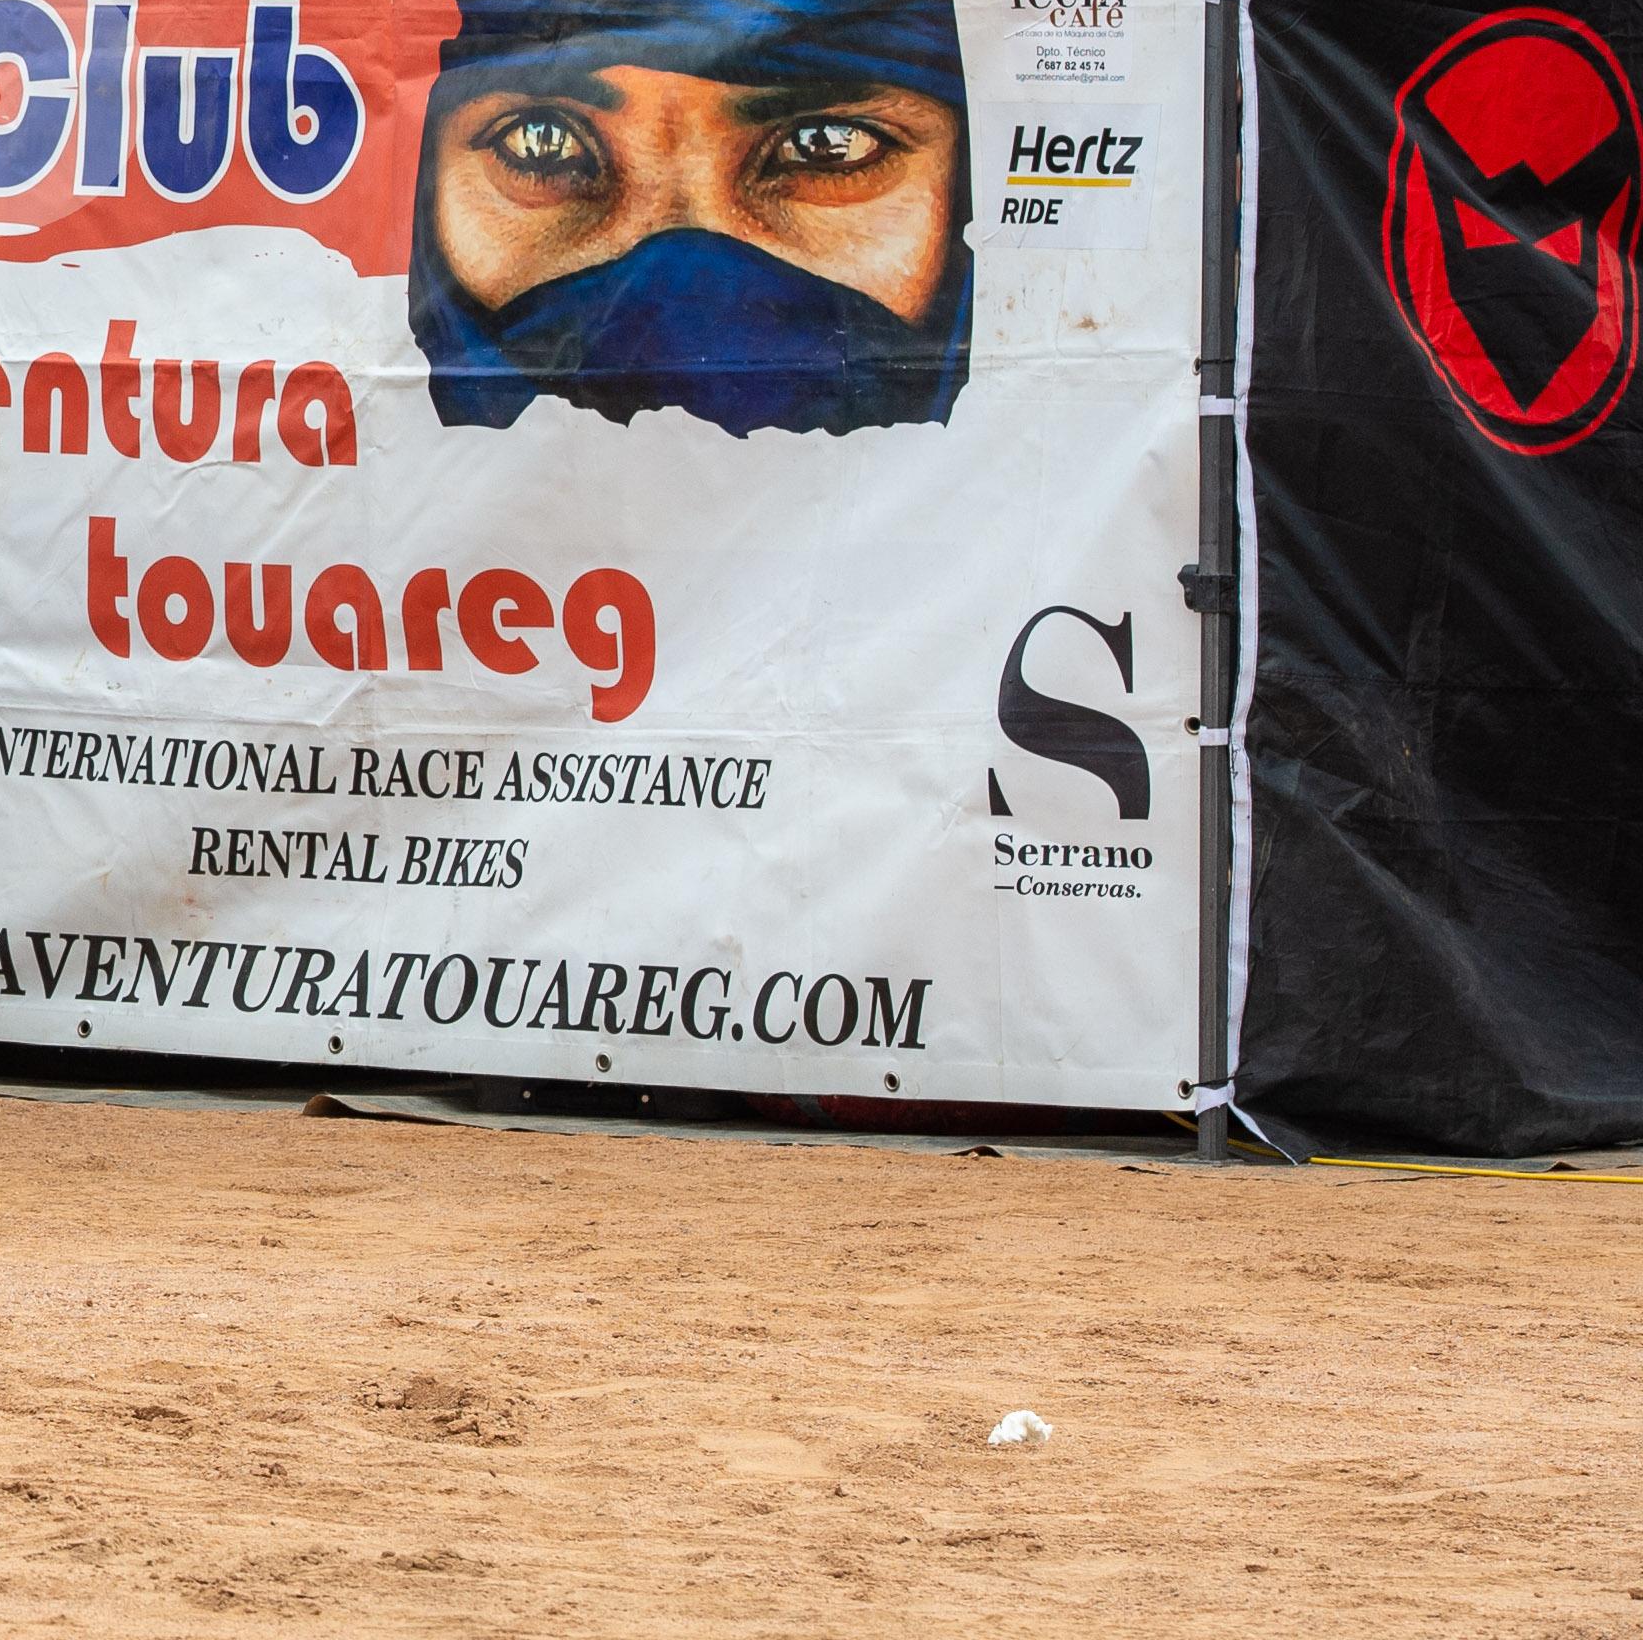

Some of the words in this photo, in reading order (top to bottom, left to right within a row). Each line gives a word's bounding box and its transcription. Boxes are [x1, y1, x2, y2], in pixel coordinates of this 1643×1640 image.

[1036, 46, 1063, 58] Dpto.
[1067, 45, 1105, 57] Técnico
[1045, 61, 1061, 71] 687
[1065, 61, 1076, 71] 82
[1080, 61, 1091, 71] 45
[1094, 61, 1105, 71] 74
[1008, 125, 1143, 176] Hertz
[1001, 198, 1063, 225] RIDE
[87, 516, 656, 722] touareg
[349, 747, 483, 800] RACE
[495, 751, 772, 811] ASSISTANCE
[188, 827, 389, 884] RENTAL
[396, 835, 529, 889] BIKES
[993, 833, 1153, 871] Serrano
